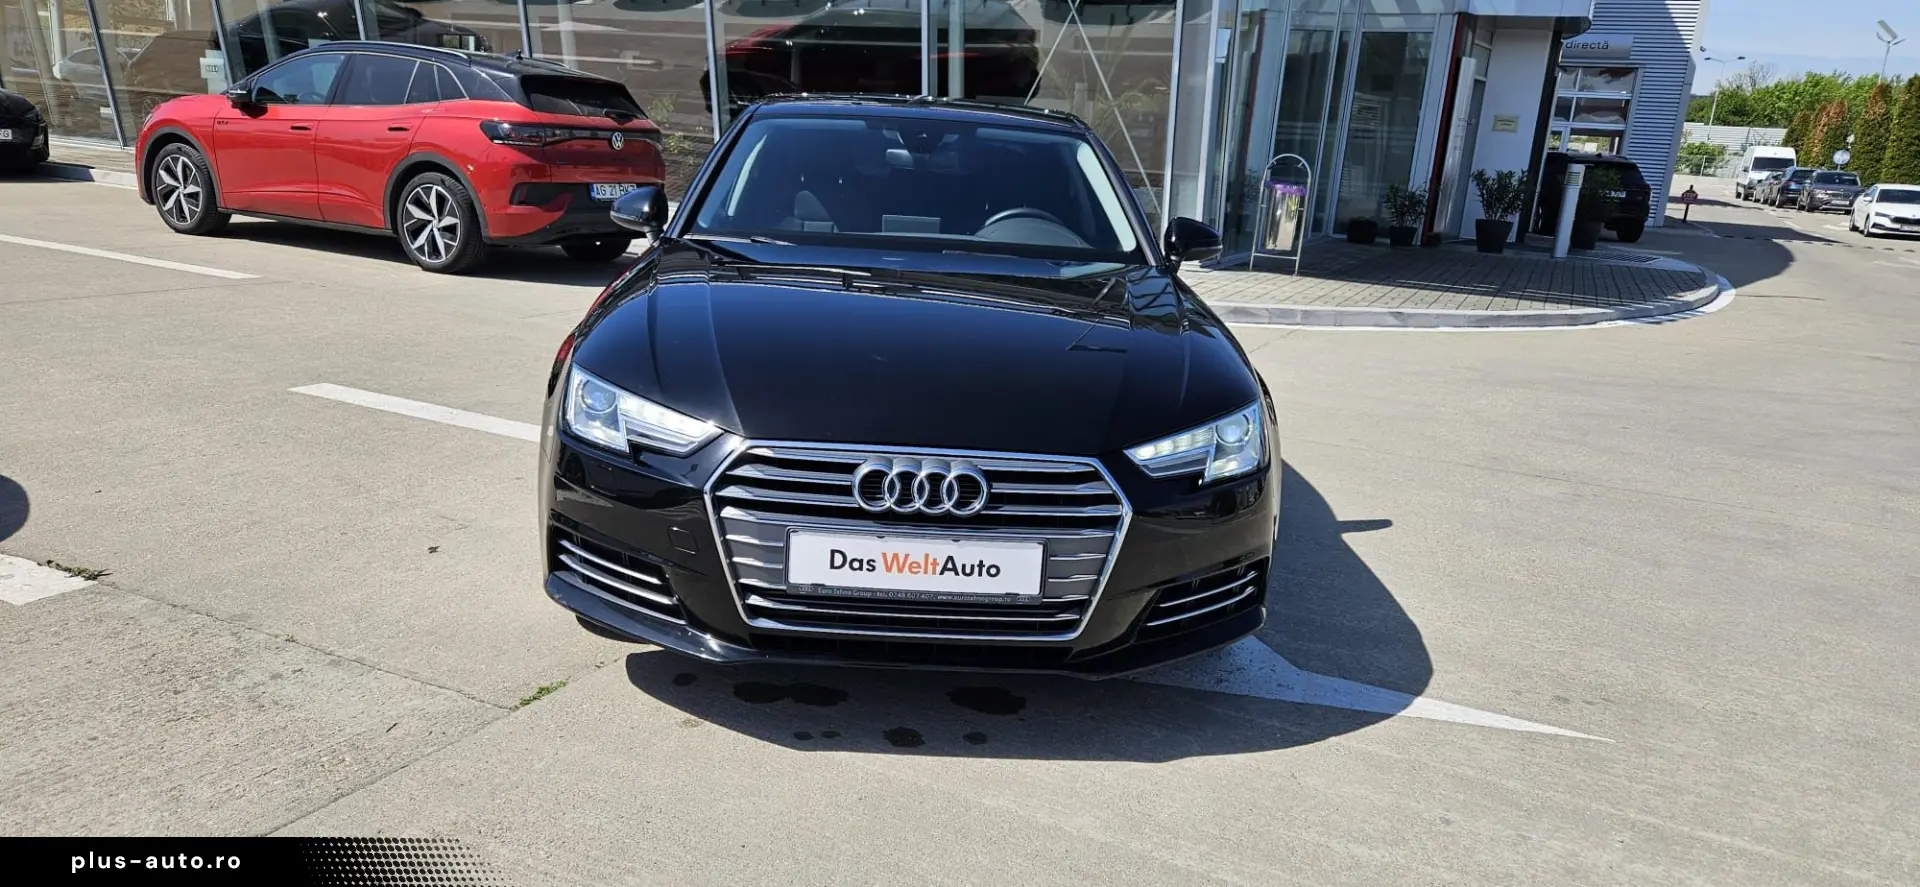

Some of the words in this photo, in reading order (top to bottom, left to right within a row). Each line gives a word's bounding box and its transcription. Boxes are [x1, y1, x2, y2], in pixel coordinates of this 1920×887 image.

[1565, 40, 1609, 50] directă
[596, 184, 606, 197] AG
[609, 184, 617, 197] 21
[829, 549, 876, 573] Das
[881, 551, 1001, 578] WeltAuto
[833, 588, 851, 596] Tehno
[852, 589, 872, 597] Group
